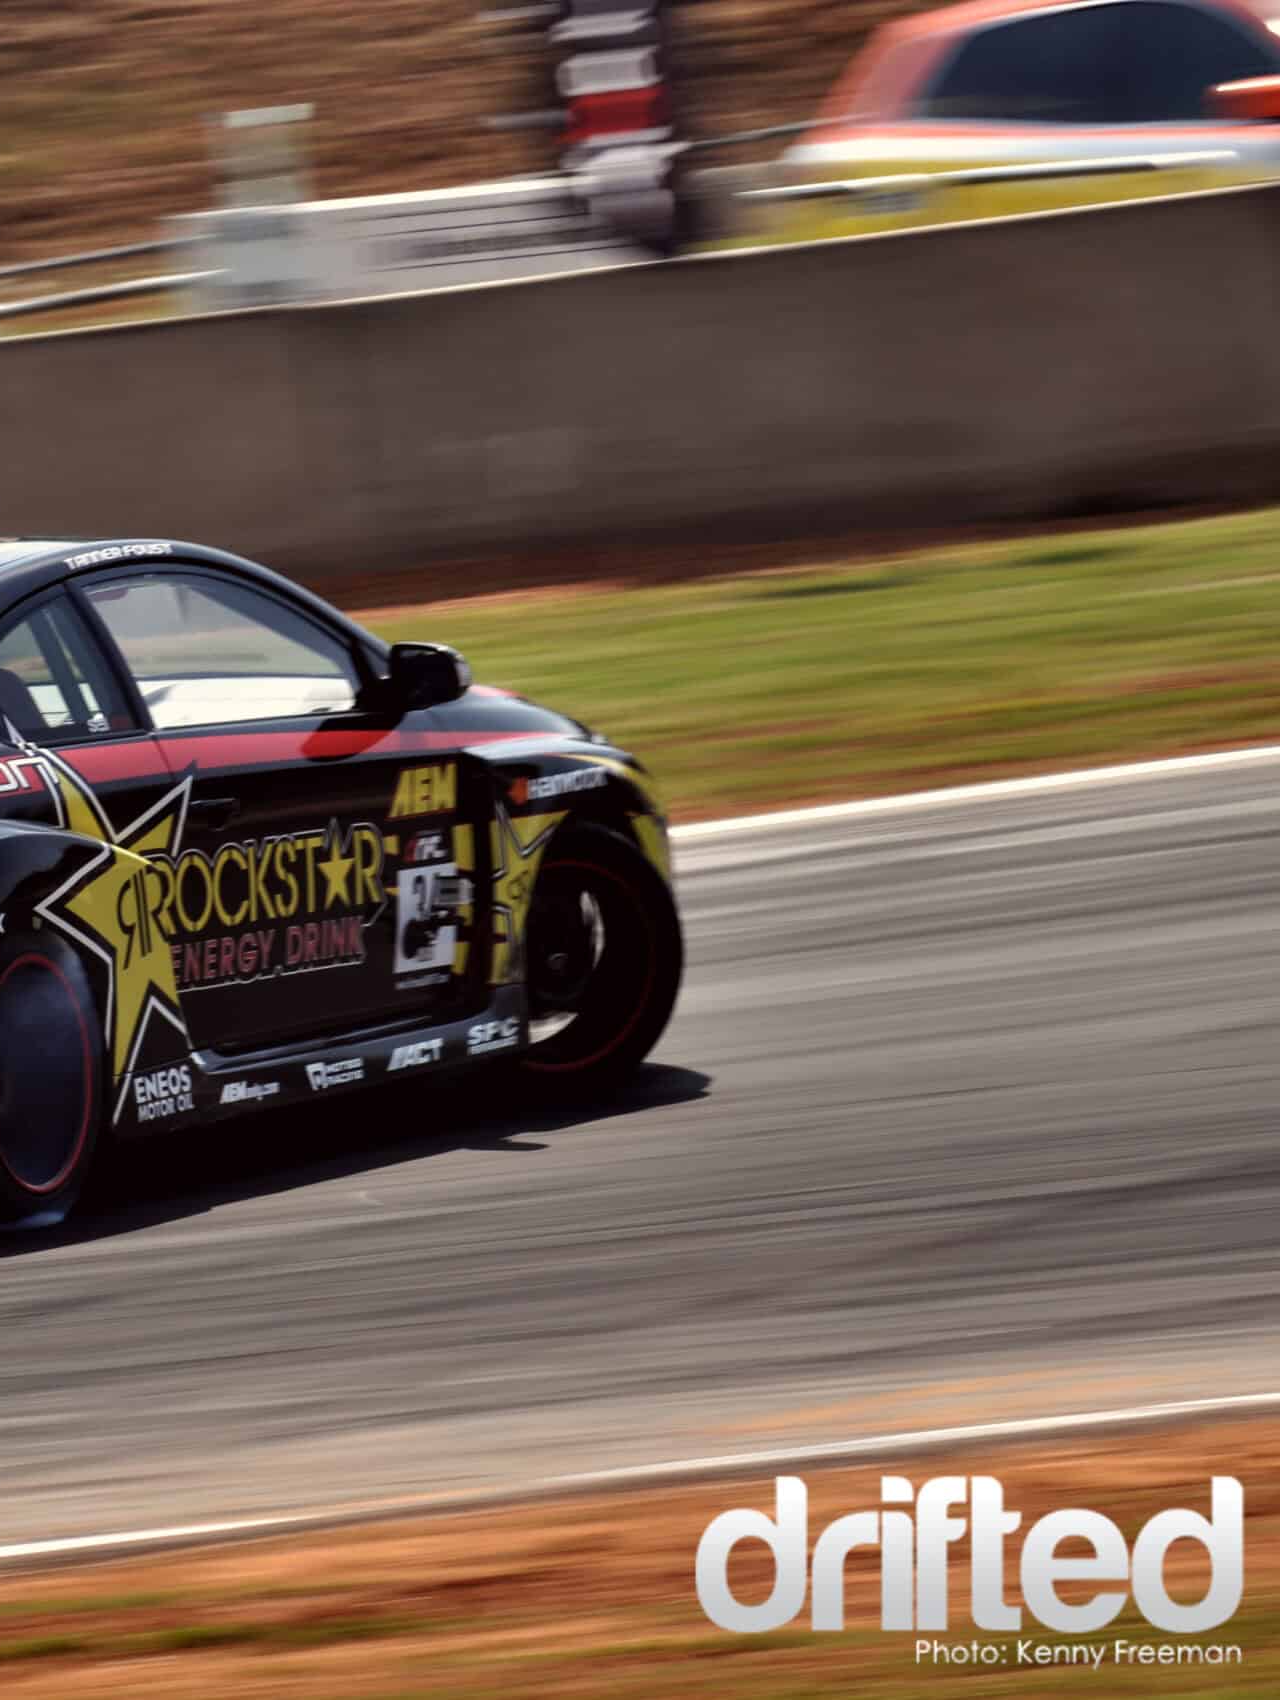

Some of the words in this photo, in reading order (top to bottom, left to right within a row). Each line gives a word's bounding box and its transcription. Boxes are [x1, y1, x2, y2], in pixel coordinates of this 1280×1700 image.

[63, 547, 122, 570] TANNER
[122, 543, 173, 558] FOUST
[388, 763, 457, 818] AEM
[170, 928, 276, 985] ENERGY
[286, 915, 364, 966] DRINK
[468, 1016, 520, 1045] SPC
[134, 1065, 191, 1104] ENEOS
[138, 1098, 176, 1122] MOTOR
[177, 1093, 195, 1112] OIL
